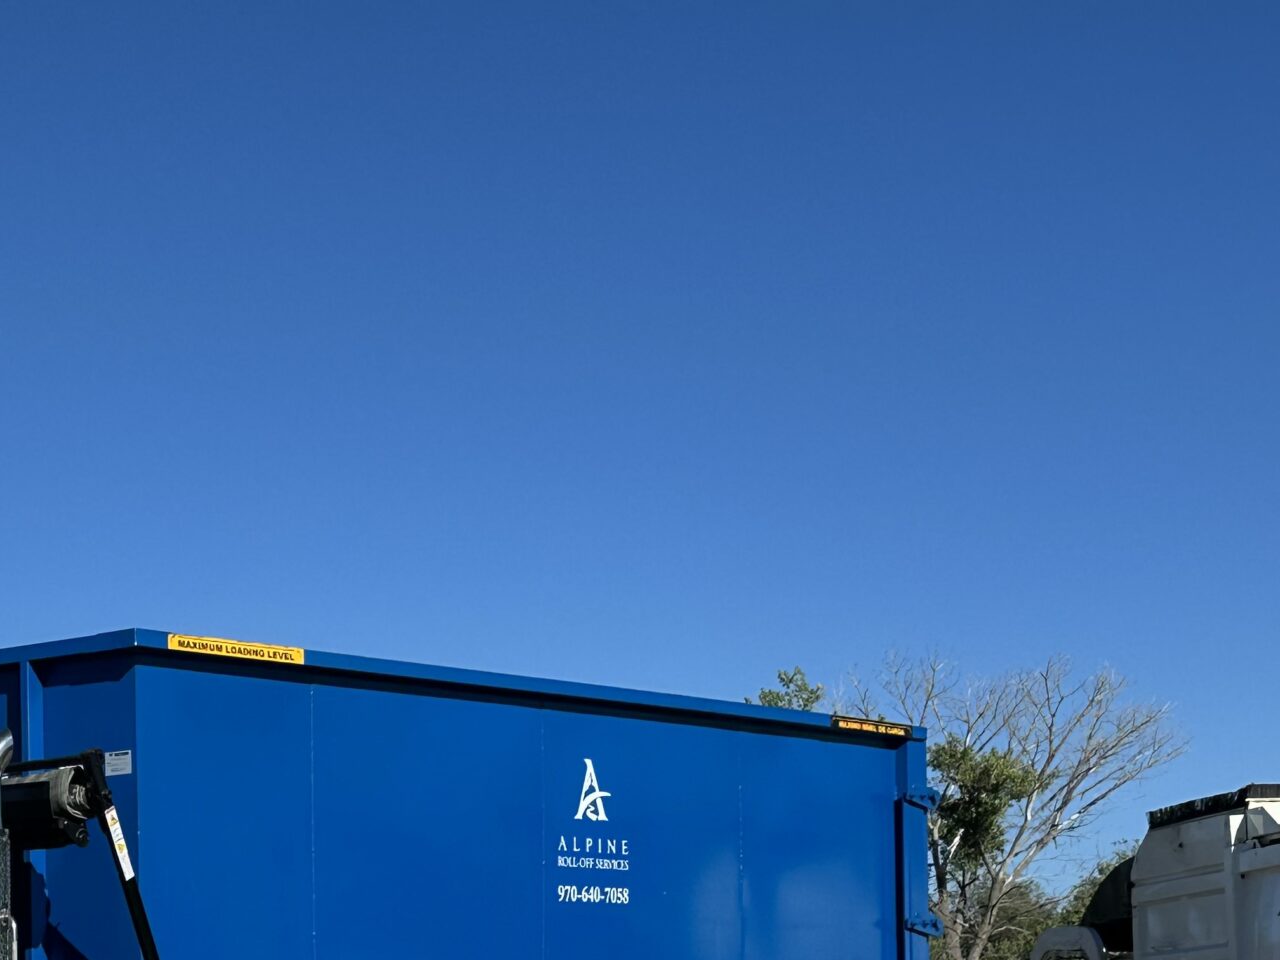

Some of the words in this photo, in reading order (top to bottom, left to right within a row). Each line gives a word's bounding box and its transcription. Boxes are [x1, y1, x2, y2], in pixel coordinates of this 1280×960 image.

[177, 639, 223, 653] MAXIMUM
[225, 644, 265, 658] LOADING
[267, 650, 295, 661] LEVEL
[558, 835, 629, 855] ALPINE
[557, 855, 595, 869] ROLL-OFF
[595, 858, 629, 871] SERVICES
[557, 885, 629, 904] 970-640-7058
